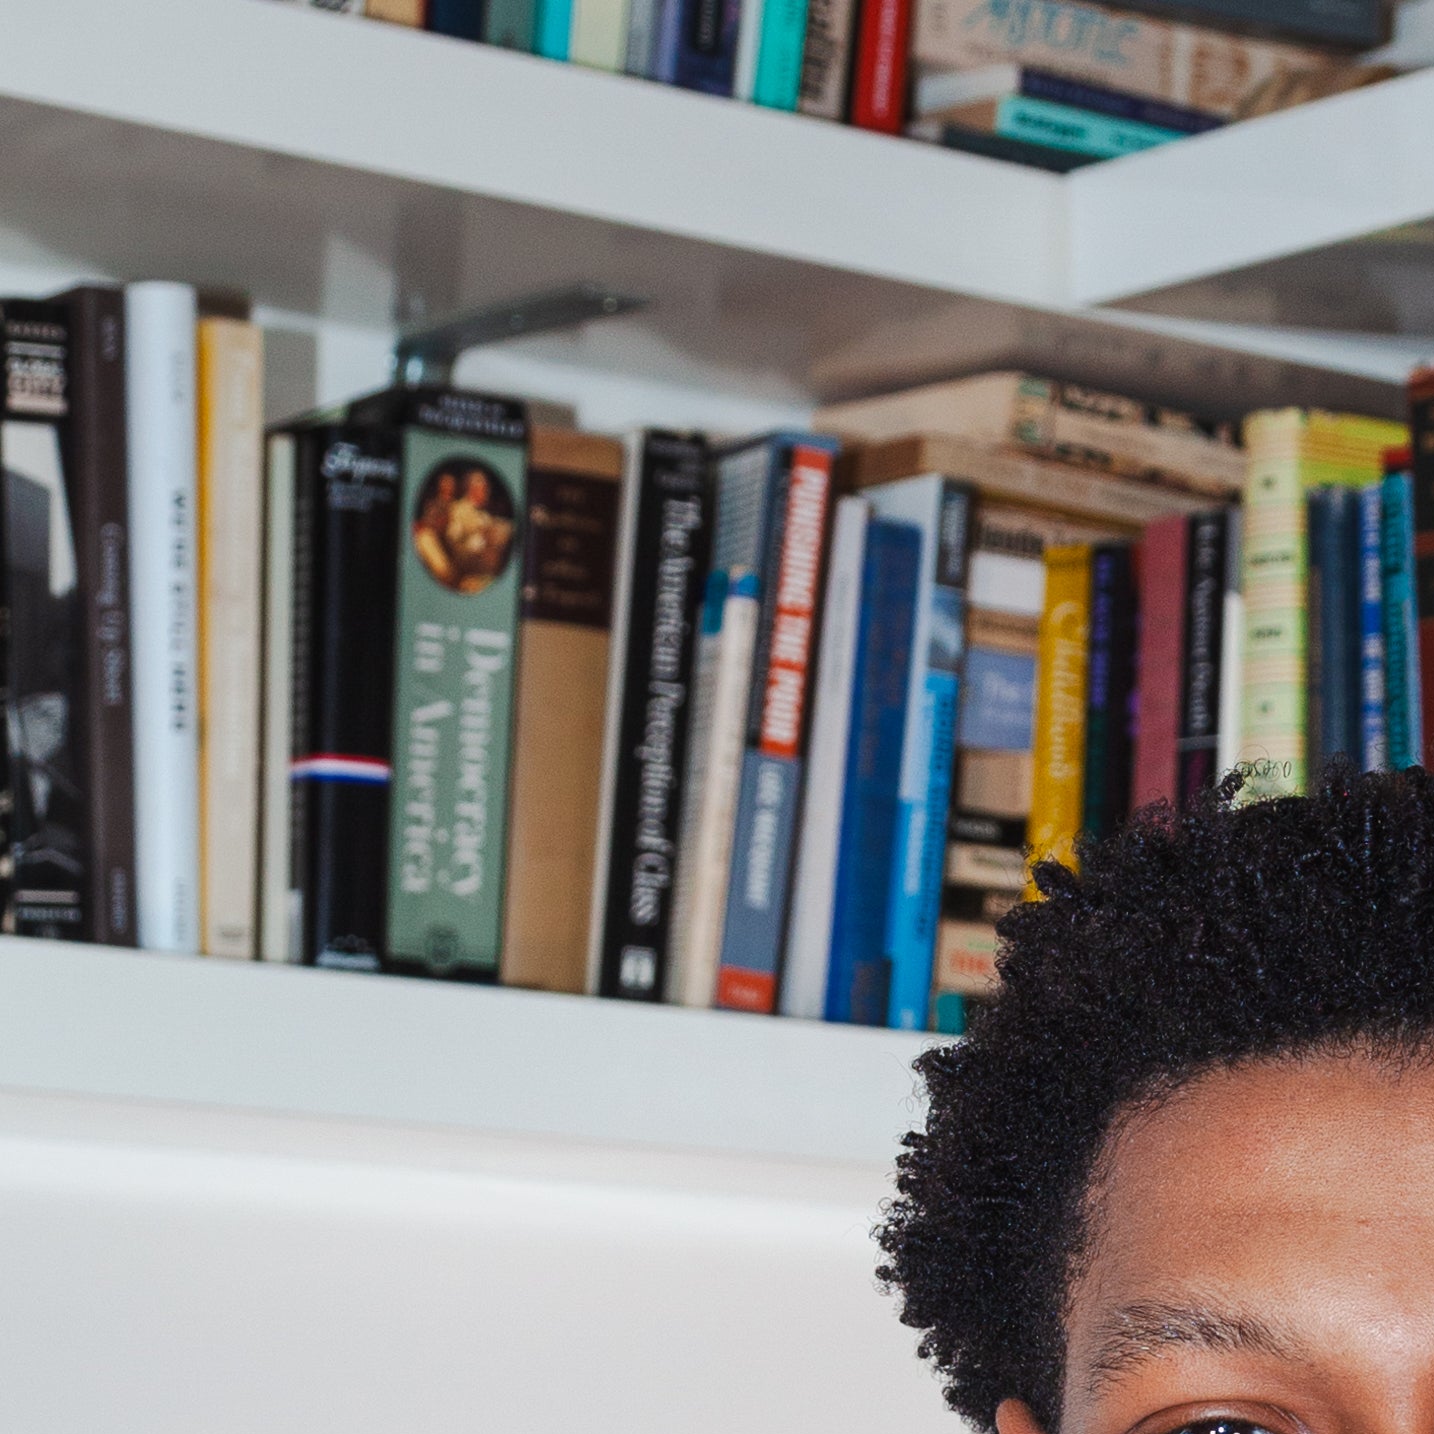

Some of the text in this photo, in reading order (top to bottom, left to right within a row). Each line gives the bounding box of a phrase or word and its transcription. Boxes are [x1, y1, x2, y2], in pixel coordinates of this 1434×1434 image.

[660, 498, 702, 553] The
[650, 556, 695, 680] American
[763, 465, 829, 742] PUNISHING THE POOR
[401, 622, 461, 894] in America
[436, 627, 512, 896] Democracy
[634, 680, 686, 820] Perception
[629, 853, 672, 927] Class
